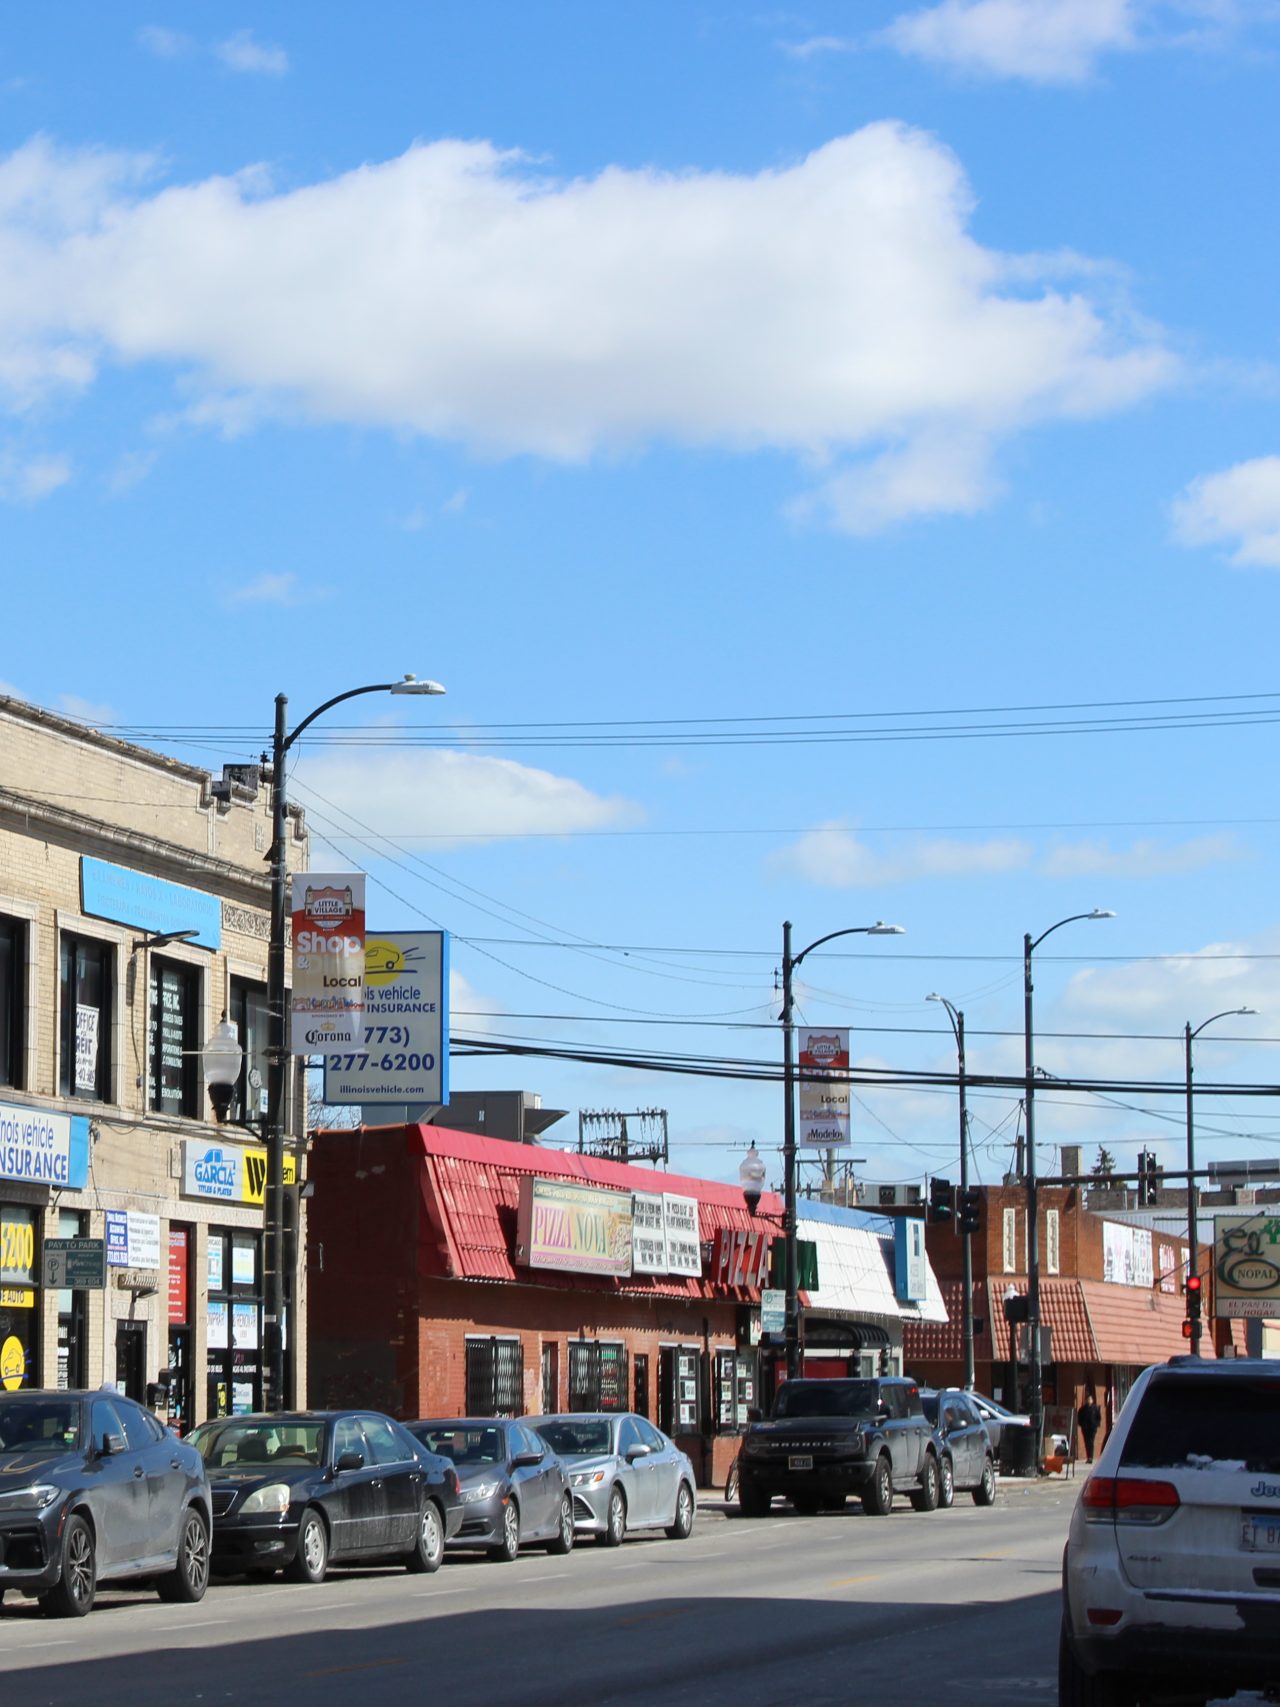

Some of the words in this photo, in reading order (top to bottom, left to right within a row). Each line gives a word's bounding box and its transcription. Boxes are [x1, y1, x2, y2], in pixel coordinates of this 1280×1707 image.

[314, 906, 343, 914] VILLAGE
[318, 900, 339, 908] LITTLE
[296, 930, 361, 958] Shop
[323, 975, 362, 988] Local
[378, 986, 421, 1001] vehicle
[367, 1002, 436, 1014] INSURANCE
[305, 1029, 352, 1047] Corona
[329, 1053, 435, 1072] 277-6200
[339, 1084, 425, 1095] illinoisvehicle.com
[821, 1095, 848, 1104] Local
[21, 1117, 54, 1150] vehicle
[810, 1128, 841, 1139] Modelo
[194, 1162, 235, 1187] GARCIA
[533, 1205, 572, 1249] PIZZA
[574, 1212, 607, 1254] NOVA
[48, 1241, 63, 1249] PAY
[65, 1241, 77, 1249] TO
[78, 1241, 100, 1249] PARK
[717, 1228, 770, 1288] PIZZA
[1237, 1268, 1276, 1280] NOPAL
[8, 1289, 25, 1304] AUTO
